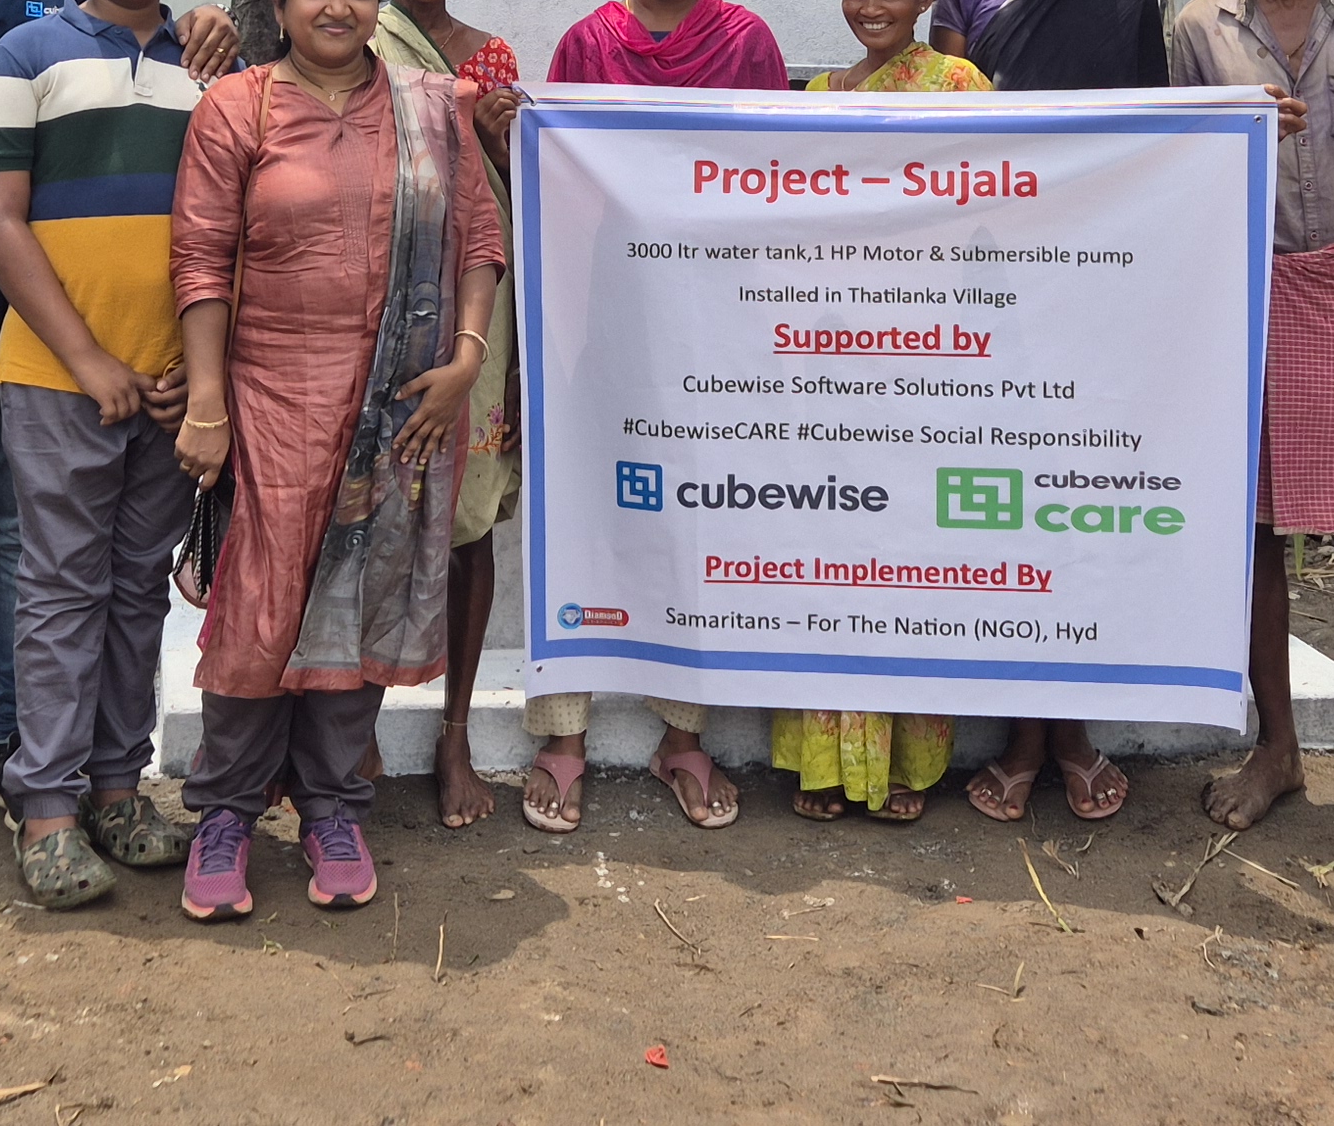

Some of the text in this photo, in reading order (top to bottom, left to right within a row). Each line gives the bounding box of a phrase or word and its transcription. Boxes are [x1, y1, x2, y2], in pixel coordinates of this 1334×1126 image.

[693, 159, 850, 204] Project
[902, 160, 1038, 206] Sujala
[626, 242, 672, 260] 3000
[678, 242, 700, 260] ltr
[705, 244, 761, 260] water
[830, 244, 857, 261] HP
[863, 245, 925, 262] Motor
[929, 245, 946, 262] &
[950, 244, 1071, 264] Submersible
[1077, 250, 1134, 269] pump
[739, 285, 1017, 309] Installed in Thatilanka Village
[773, 322, 992, 358] Supported by
[682, 373, 1075, 400] Cubewise Software Solutions Pvt Ltd
[622, 417, 1143, 453] #CubewiseCARE #Cubewise Social Responsibility
[676, 473, 890, 513] cubewise
[1033, 469, 1182, 491] cubewise
[1034, 503, 1186, 536] care
[704, 554, 1053, 591] Project Implemented By
[664, 606, 781, 631] Samaritans
[807, 613, 842, 633] For
[846, 613, 888, 634] The
[894, 616, 966, 637] Nation
[974, 617, 1048, 644] (NGO),
[1056, 621, 1098, 645] Hyd
